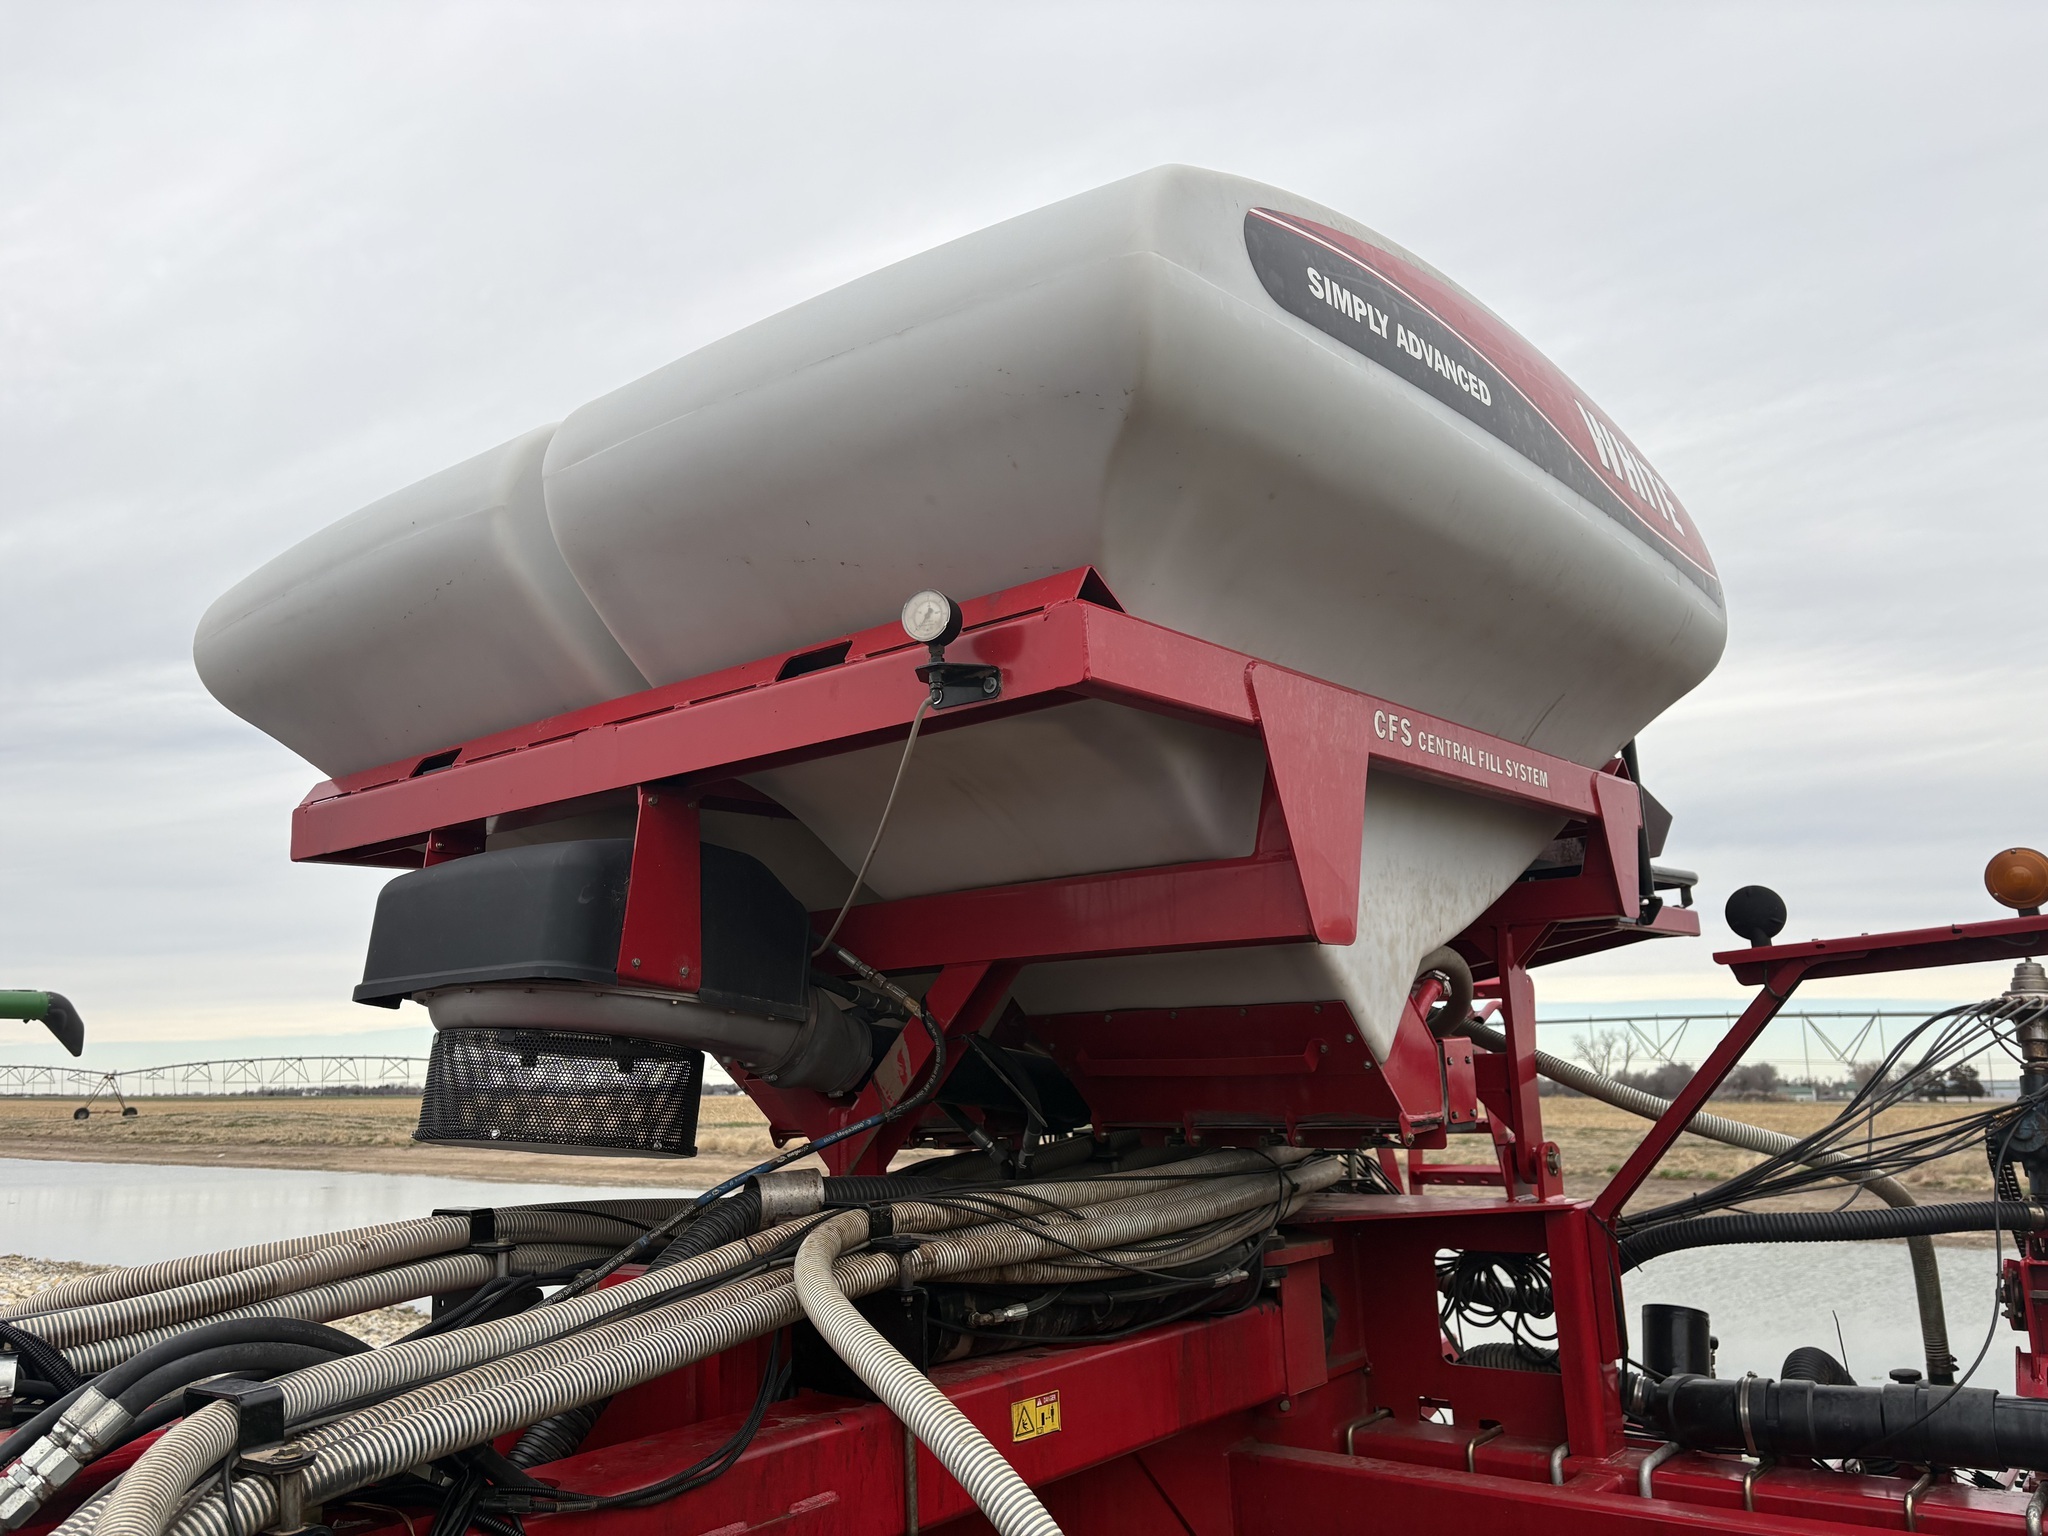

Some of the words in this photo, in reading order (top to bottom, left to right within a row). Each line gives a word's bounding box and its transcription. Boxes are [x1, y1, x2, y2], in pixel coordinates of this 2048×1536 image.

[1306, 266, 1389, 340] SIMPLY
[1396, 323, 1492, 407] ADVANCED
[1574, 398, 1685, 537] WHITE
[1374, 709, 1412, 748] CFS
[1418, 731, 1476, 766] CENTRAL
[1478, 750, 1503, 775] FILL
[1505, 759, 1549, 789] SYSTEM
